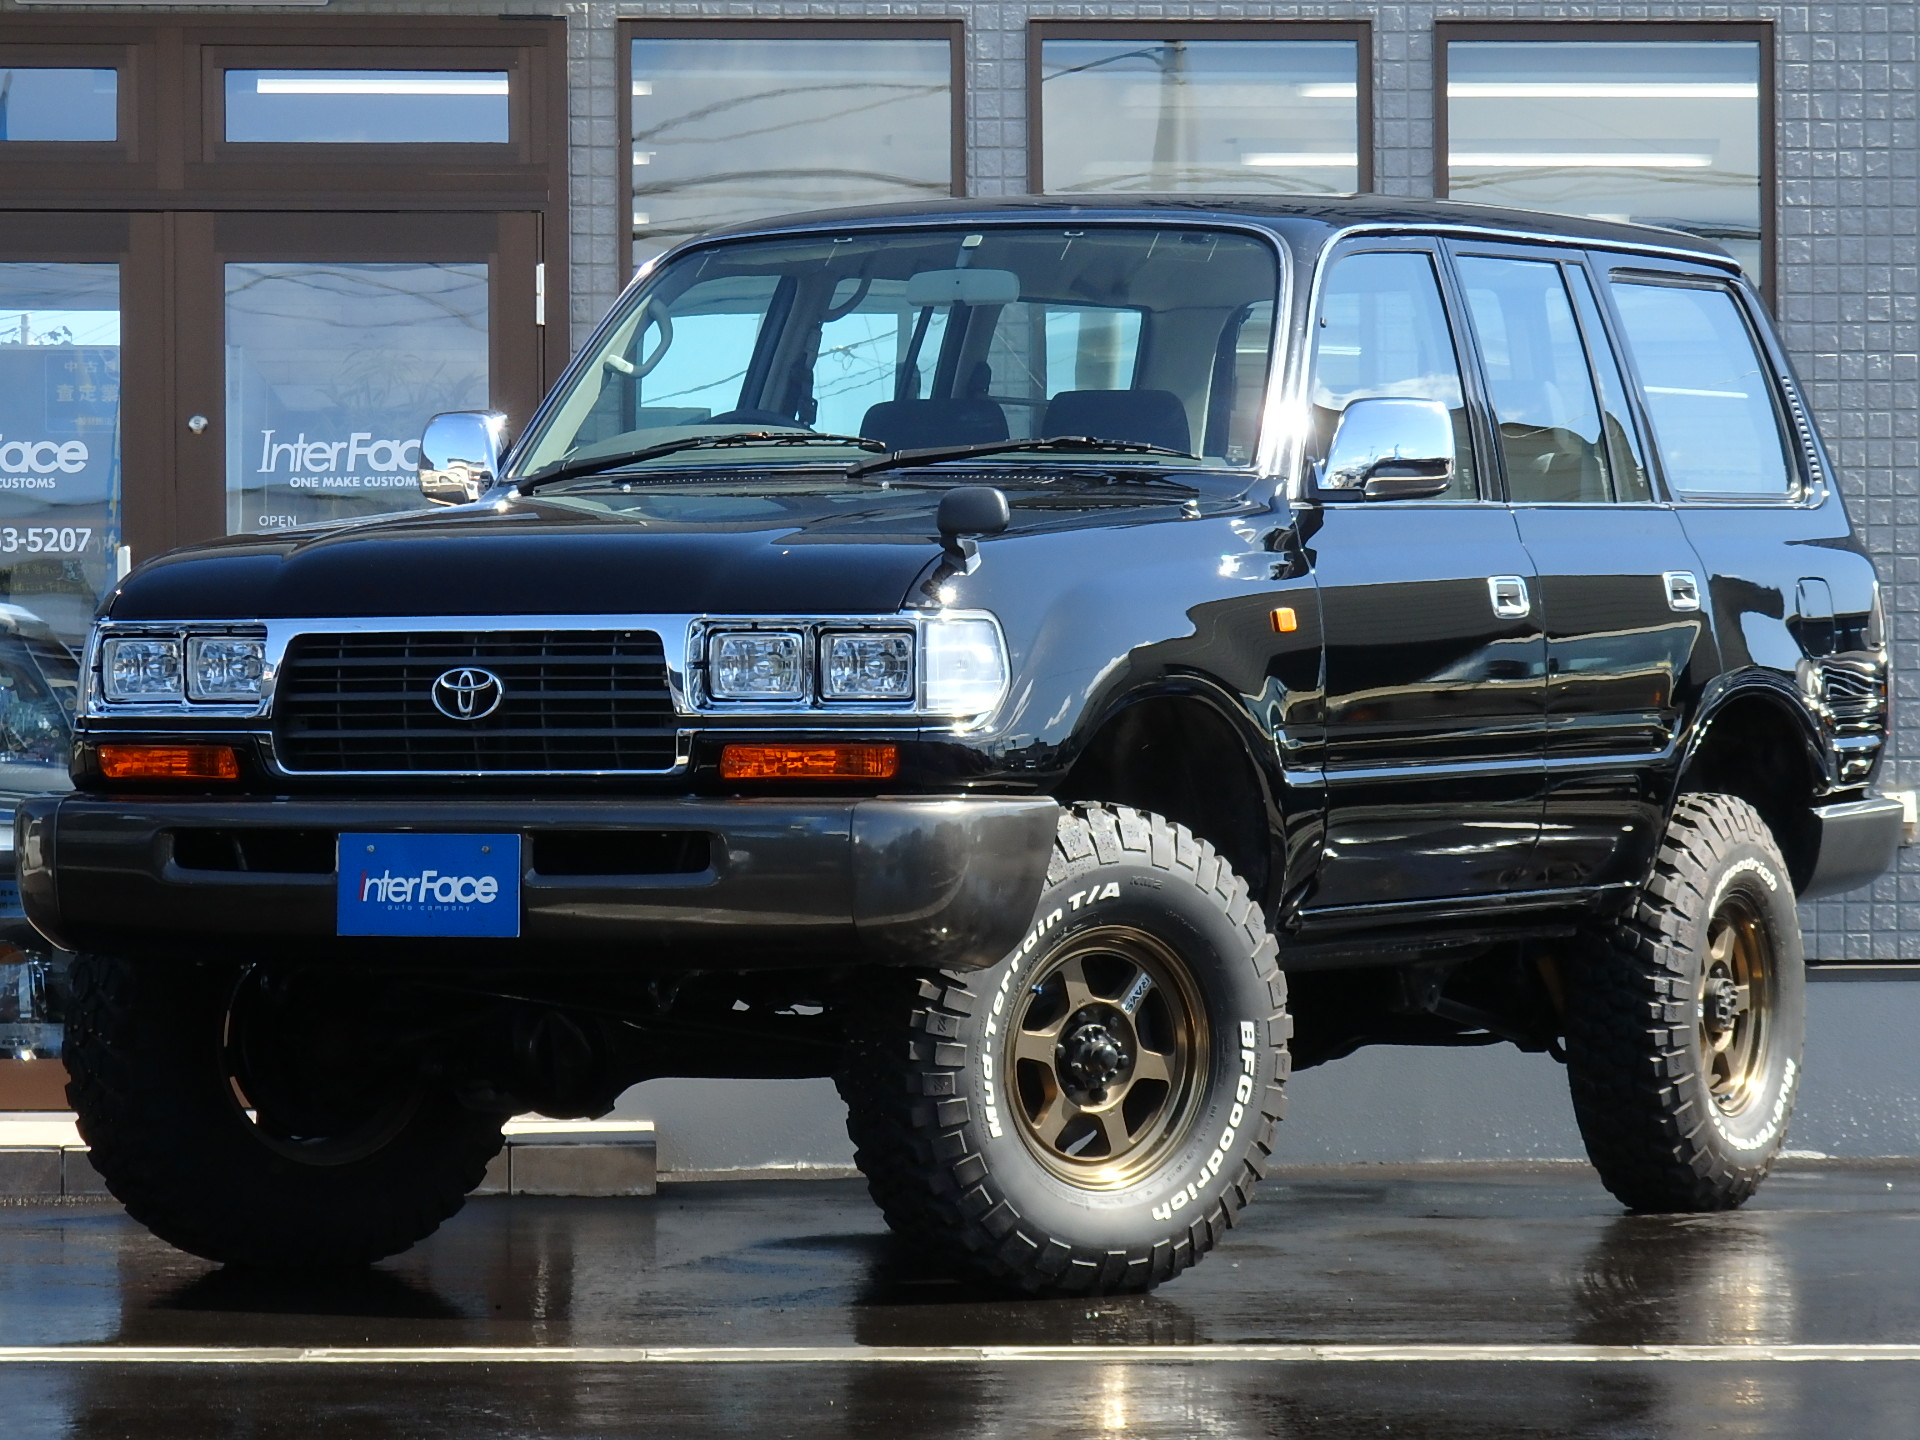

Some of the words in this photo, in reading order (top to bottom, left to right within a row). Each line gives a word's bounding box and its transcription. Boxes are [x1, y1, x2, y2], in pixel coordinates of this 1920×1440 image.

[0, 433, 88, 473] ace
[256, 429, 421, 472] InterFac
[289, 476, 319, 488] ONE
[322, 476, 361, 488] MAKE
[363, 475, 419, 487] CUSTOM
[258, 514, 297, 527] OPEN
[0, 527, 91, 553] 3-5207
[420, 904, 471, 912] company
[1067, 881, 1121, 912] T/A
[1151, 1020, 1256, 1221] BFGoodrich
